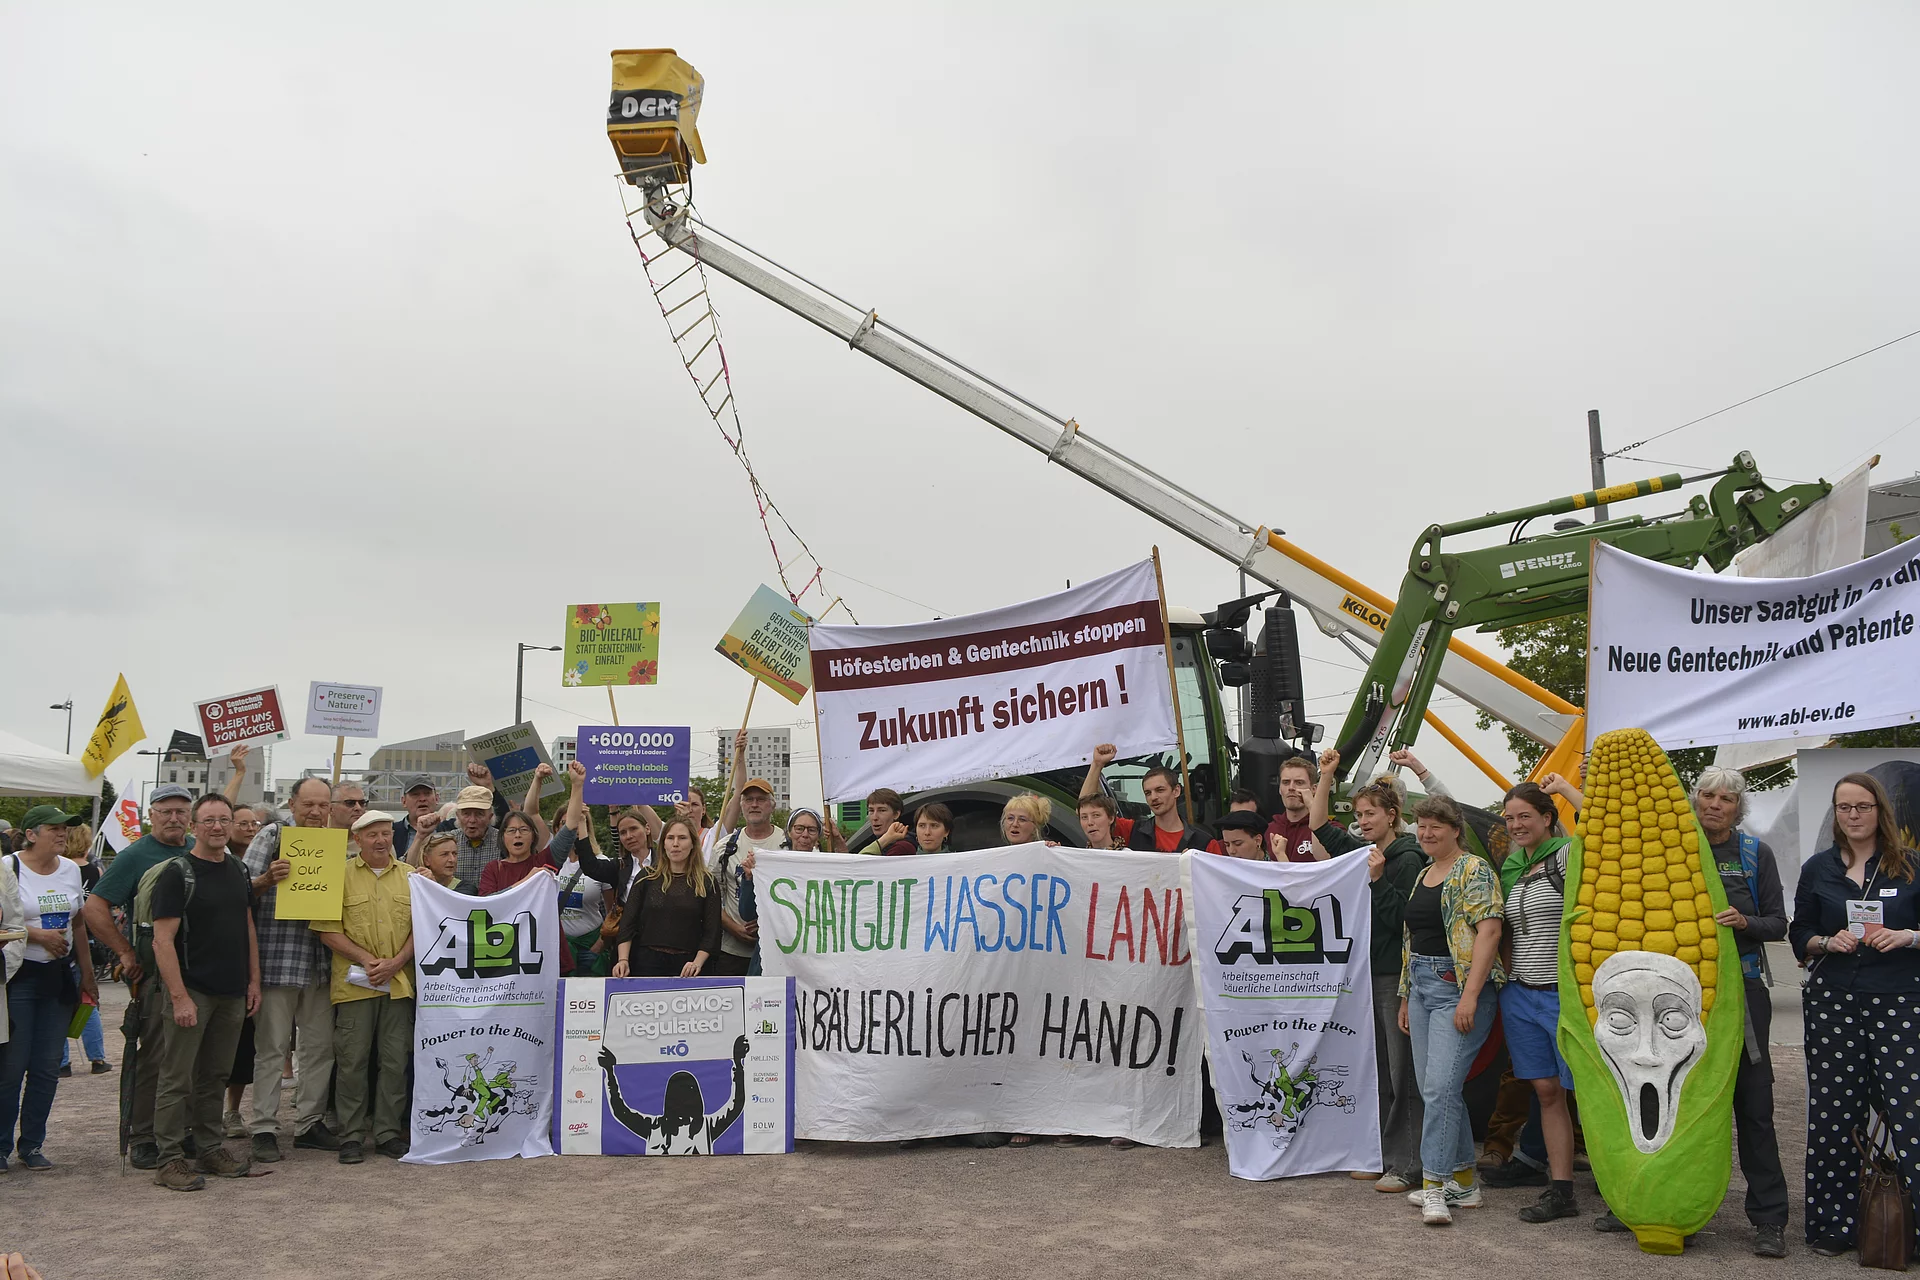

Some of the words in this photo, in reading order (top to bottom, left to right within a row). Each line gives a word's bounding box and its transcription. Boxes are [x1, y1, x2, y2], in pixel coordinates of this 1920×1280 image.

[622, 96, 678, 118] OGM
[1515, 551, 1576, 571] FENDT
[1690, 598, 1752, 624] Unser
[1757, 588, 1839, 623] Saatgut
[1842, 585, 1862, 609] in
[580, 628, 643, 642] BIO-VIELFALT
[764, 622, 771, 631] &
[771, 626, 804, 652] PATENTE?
[1409, 627, 1426, 659] COMPACT
[1608, 645, 1661, 672] Neue
[1668, 642, 1784, 672] Gentechnik
[1828, 610, 1914, 650] Patente
[576, 644, 596, 654] STATT
[599, 643, 645, 654] GENTECHNIK-
[751, 629, 782, 655] BLEIBT
[780, 648, 801, 668] UNS
[829, 651, 942, 678] Höfesterben
[948, 646, 962, 665] &
[966, 630, 1070, 663] Gentechnik
[1074, 617, 1146, 645] stoppen
[595, 655, 624, 665] EINFALT!
[740, 640, 763, 661] VOM
[761, 656, 795, 682] ACKER!
[226, 695, 263, 708] Gentechnik
[328, 690, 365, 700] Preserve
[234, 702, 262, 714] Patente?
[328, 700, 358, 710] Nature
[858, 695, 984, 750] Zukunft
[992, 676, 1108, 730] sichern
[1115, 664, 1129, 704] !
[213, 715, 249, 732] BLEIBT
[251, 711, 272, 723] UNS
[1738, 702, 1855, 731] www.abl-ev.de
[214, 730, 237, 742] VOM
[240, 721, 275, 737] ACKER!
[472, 733, 511, 752] PROTECT
[512, 728, 531, 740] OUR
[494, 742, 517, 755] FOOD
[588, 732, 674, 749] +600,000
[602, 763, 625, 773] Keep
[501, 774, 521, 788] STOP
[598, 776, 614, 786] Say
[638, 776, 672, 786] patents
[286, 839, 324, 858] Save
[298, 865, 322, 875] our
[290, 882, 328, 892] seeds
[38, 893, 69, 904] PROTECT
[40, 904, 53, 913] OUR
[55, 903, 71, 912] FOOD
[770, 878, 918, 954] SAATGUT
[924, 874, 1070, 954] WASSER
[1086, 882, 1191, 966] LAND
[1222, 970, 1320, 983] Arbeitsgemeinschaft
[423, 981, 515, 994] Arbeitsgemeinschaft
[1224, 984, 1270, 993] bäuerliche
[1274, 983, 1342, 993] Landwirtschaf
[423, 993, 470, 1003] bäuerliche
[473, 991, 534, 1003] Landwirtschaft
[570, 1001, 595, 1009] SOS
[616, 999, 668, 1018] Keep
[672, 994, 733, 1013] GMOs
[626, 1014, 723, 1040] regulated
[812, 987, 1018, 1058] BÄUERLICHER
[1040, 993, 1184, 1076] HAND!
[1223, 1023, 1268, 1042] Power
[1273, 1020, 1288, 1030] to
[1292, 1018, 1316, 1031] the
[420, 1029, 466, 1050] Power
[470, 1026, 484, 1036] to
[488, 1024, 510, 1036] the
[512, 1026, 544, 1047] Bauer
[569, 1122, 588, 1132] agir
